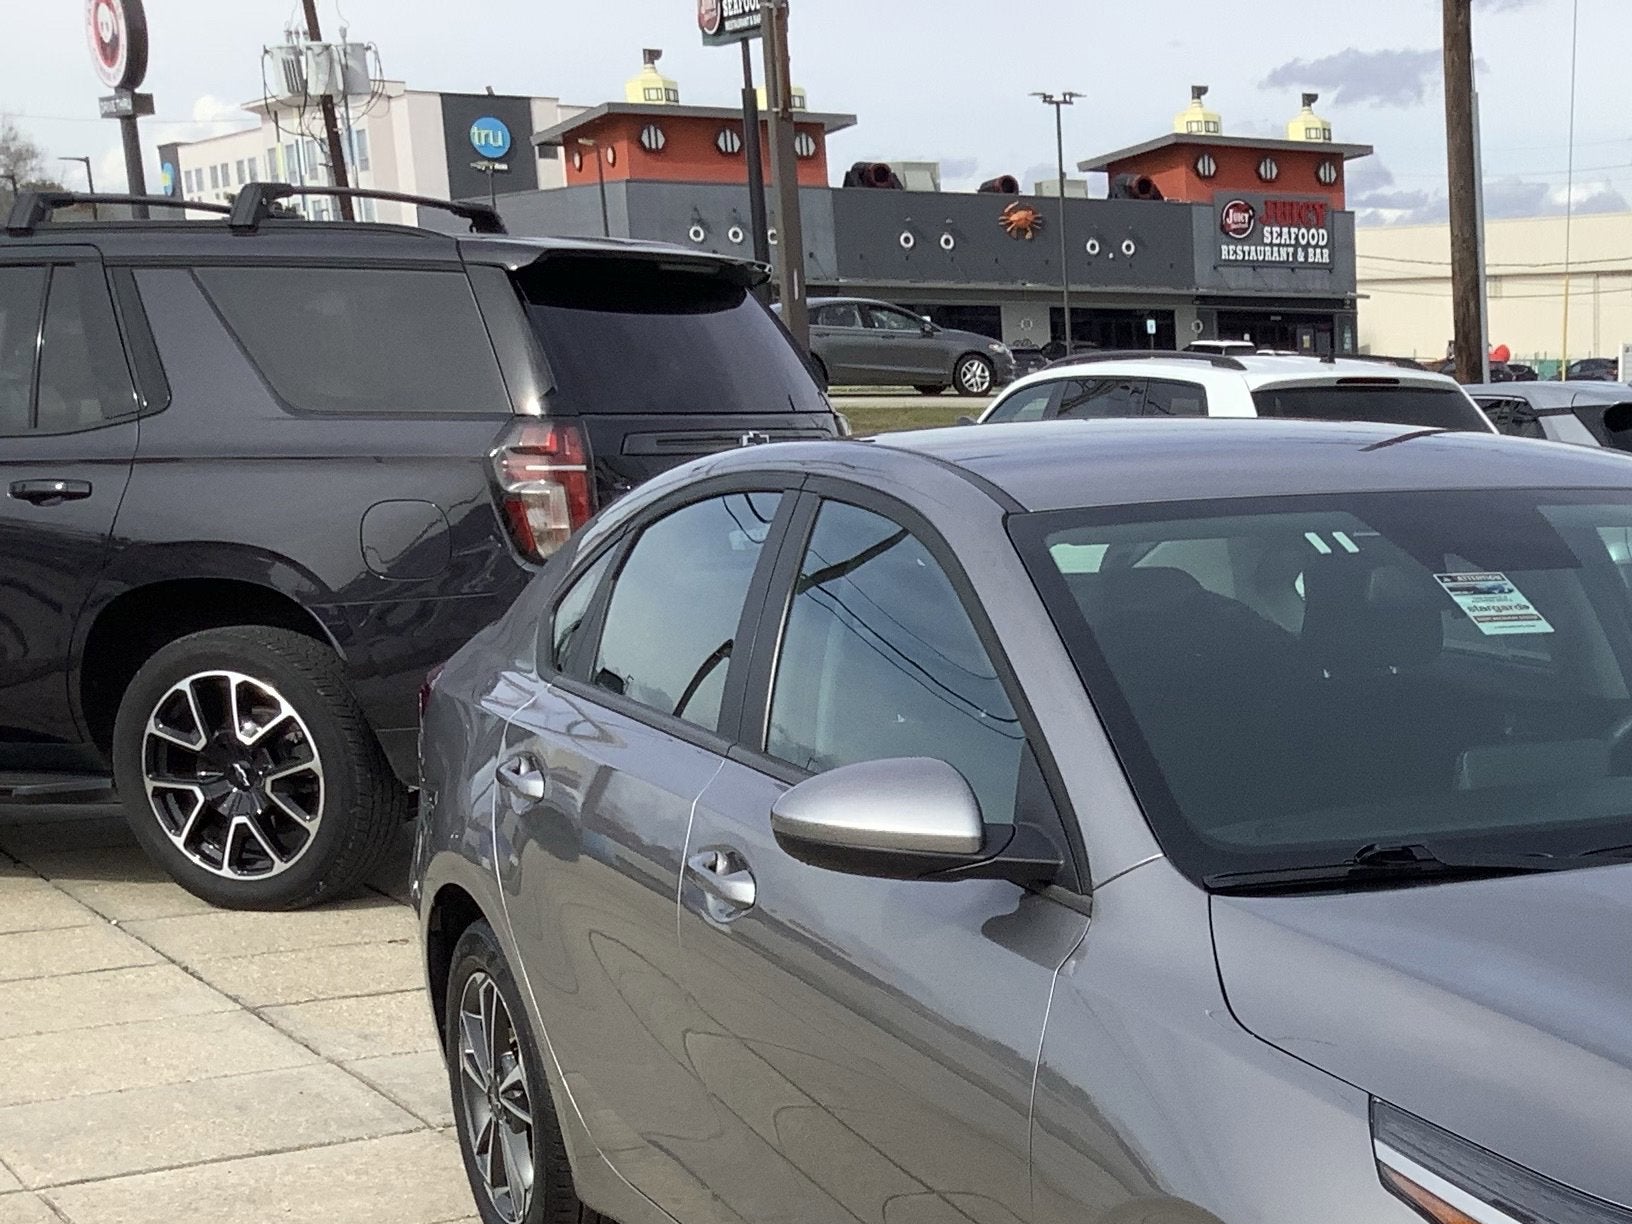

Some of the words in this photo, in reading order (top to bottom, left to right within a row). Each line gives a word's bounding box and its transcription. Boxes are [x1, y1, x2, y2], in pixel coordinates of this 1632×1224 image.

[471, 126, 504, 148] tru
[1260, 201, 1328, 227] JUICY
[1263, 226, 1328, 246] SEAFOOD
[1221, 245, 1295, 261] RESTAURANT
[1297, 247, 1305, 262] &
[1308, 248, 1330, 263] BAR
